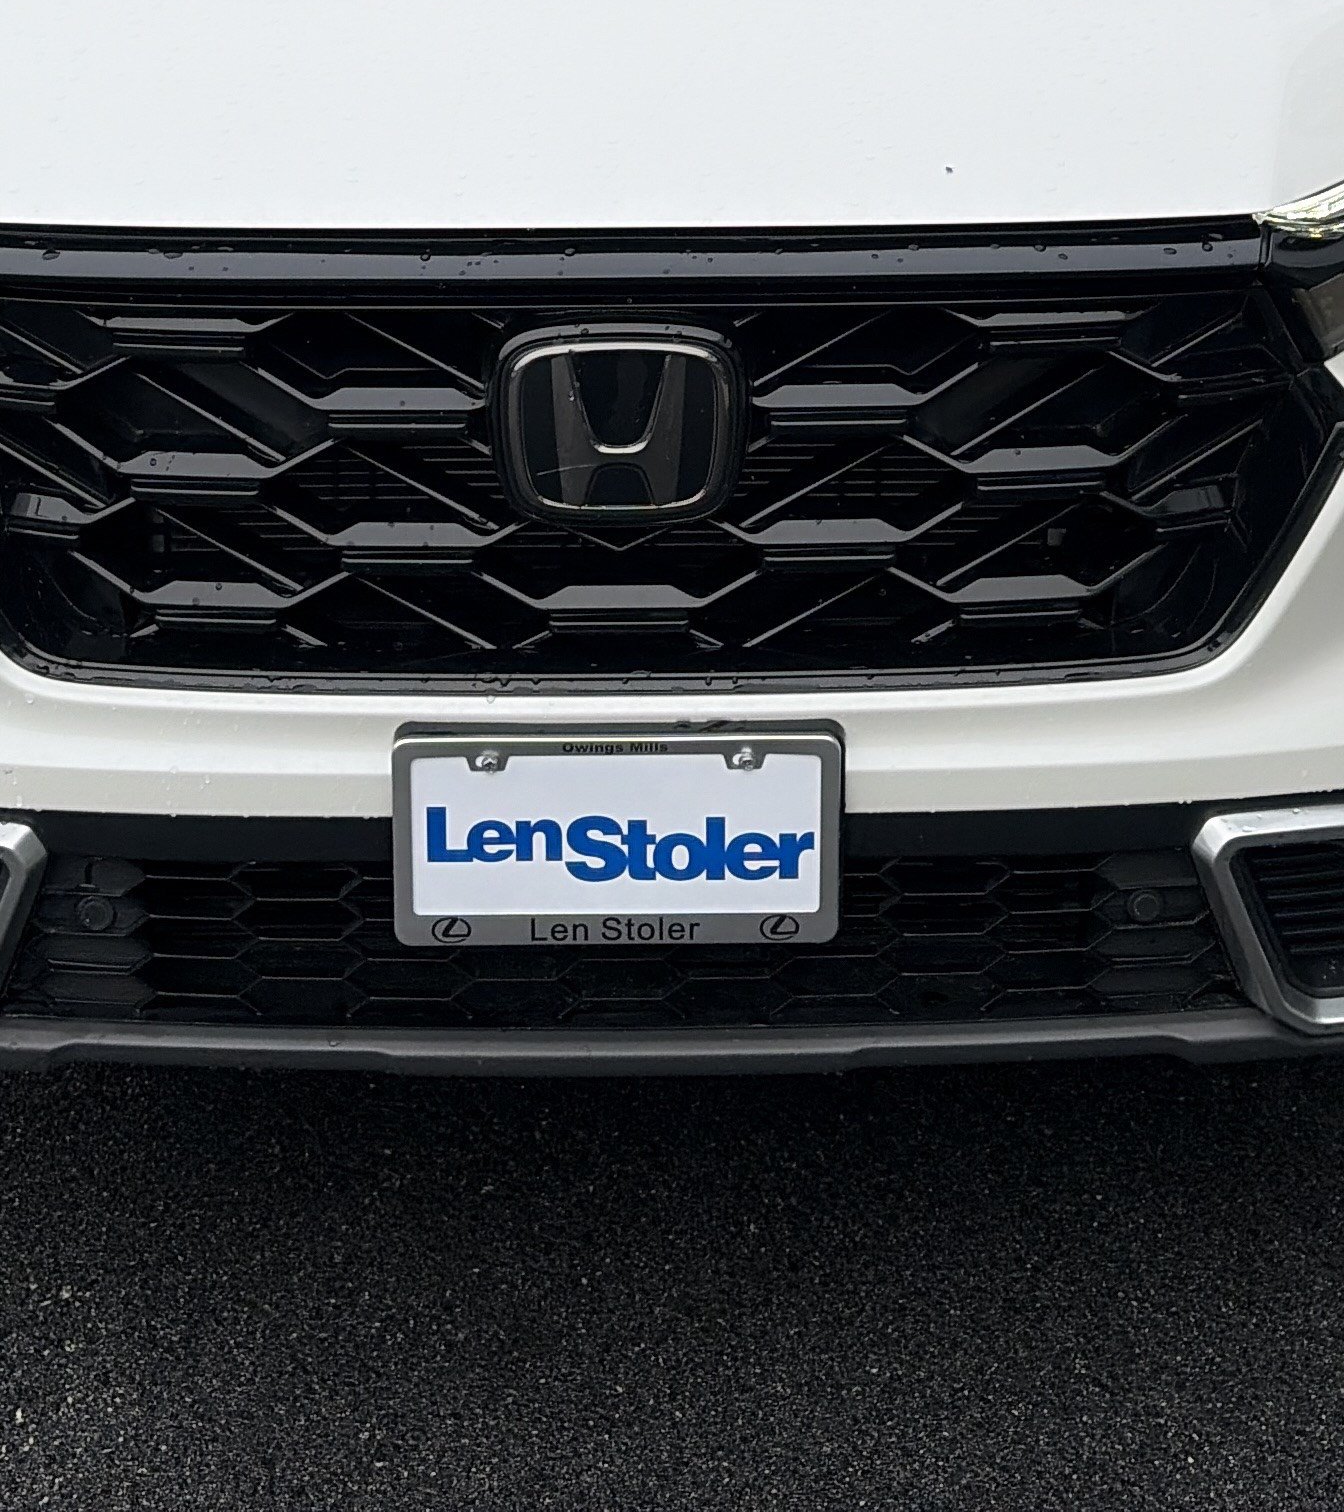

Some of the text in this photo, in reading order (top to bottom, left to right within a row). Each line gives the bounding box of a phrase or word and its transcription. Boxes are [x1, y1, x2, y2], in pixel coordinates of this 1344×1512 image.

[562, 741, 669, 755] Owings Mills
[530, 916, 700, 942] Len Stoler
